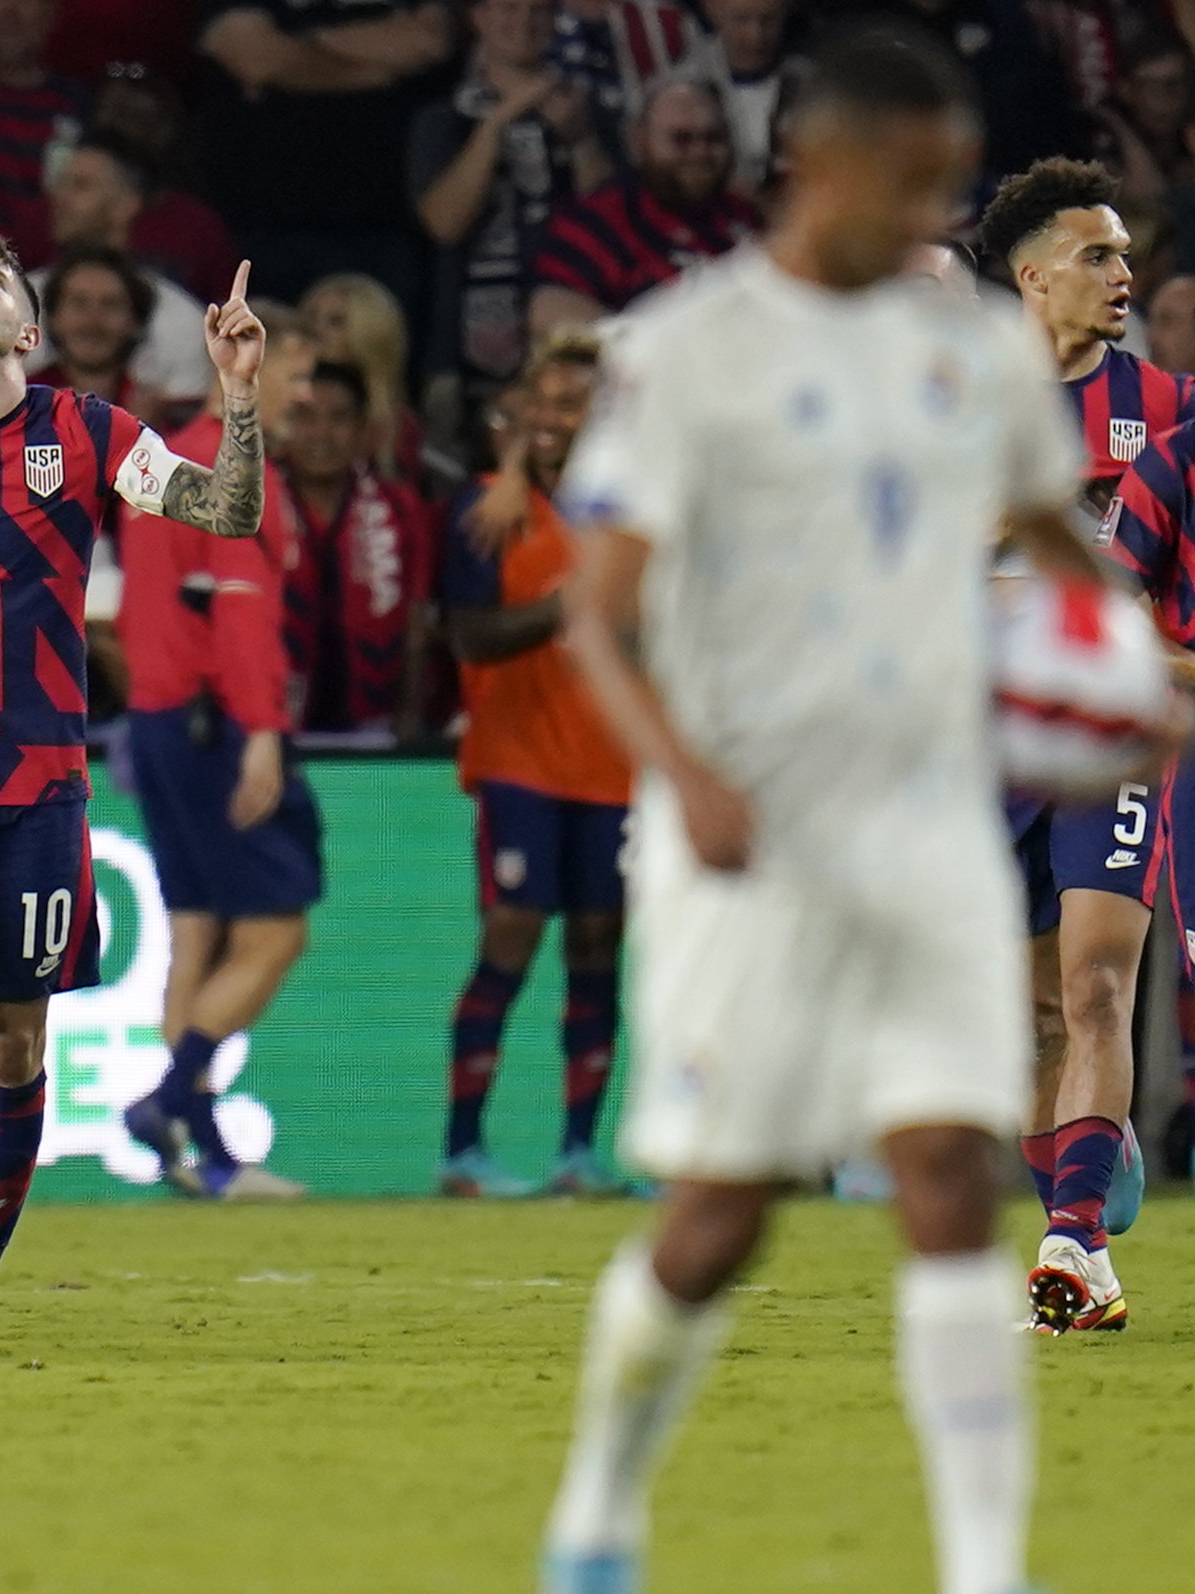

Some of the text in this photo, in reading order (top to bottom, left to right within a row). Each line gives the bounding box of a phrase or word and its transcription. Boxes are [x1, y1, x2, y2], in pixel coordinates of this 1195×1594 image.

[1113, 422, 1144, 441] USA
[27, 448, 60, 467] USA
[1114, 781, 1149, 846] 5
[21, 887, 72, 959] 10
